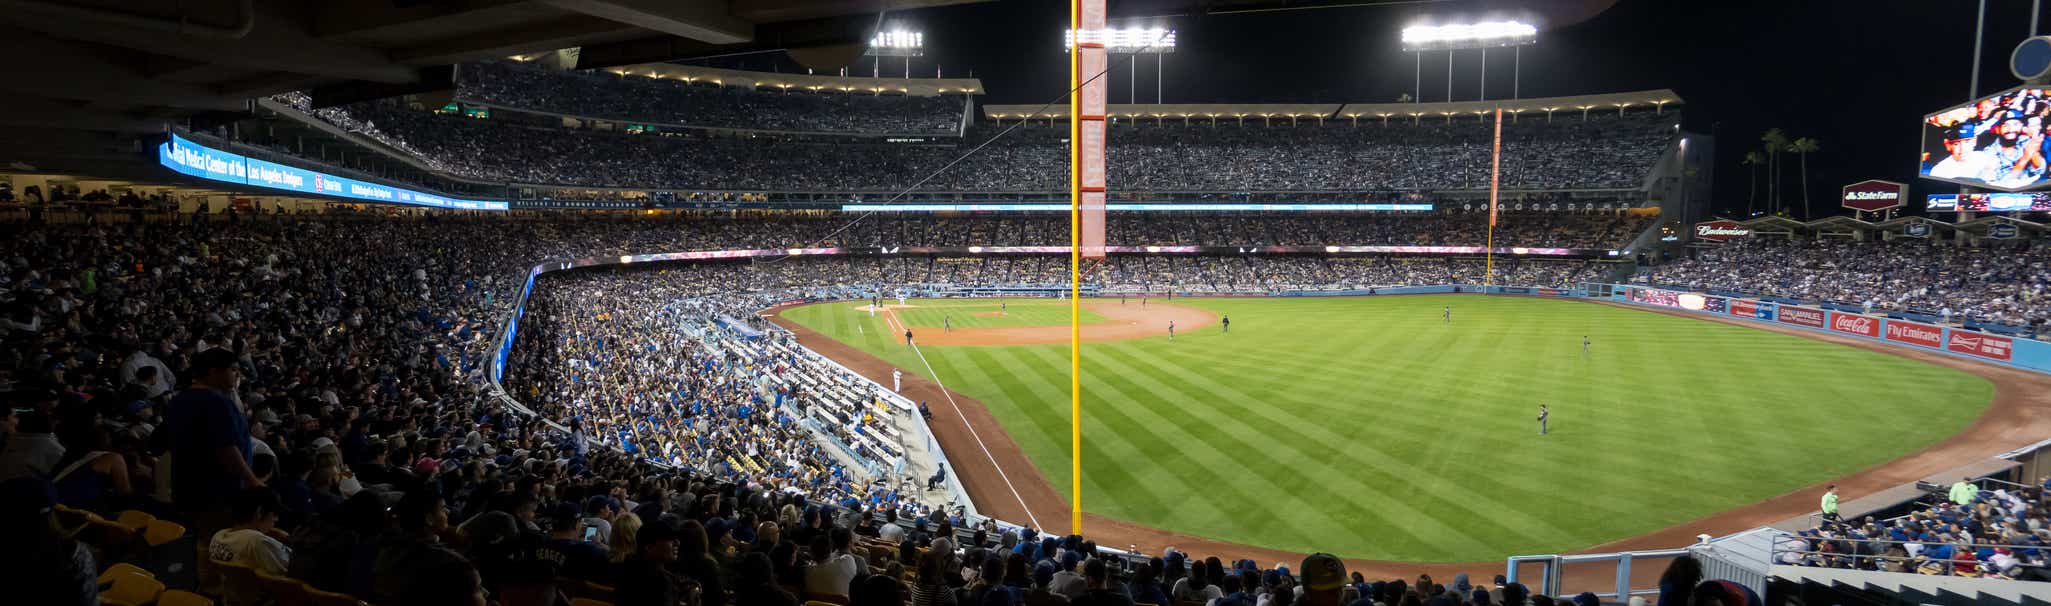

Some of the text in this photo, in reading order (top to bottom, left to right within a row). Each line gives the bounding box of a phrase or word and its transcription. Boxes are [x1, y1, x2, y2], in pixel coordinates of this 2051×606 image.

[205, 154, 228, 174] Center
[228, 159, 236, 175] of
[247, 163, 259, 179] Los
[260, 165, 282, 184] Angeles
[282, 170, 303, 188] Dodgers
[1696, 225, 1749, 237] Budweiser
[1796, 310, 1823, 321] MANUEL
[1887, 324, 1902, 338] Fly
[1902, 326, 1941, 345] Emirates
